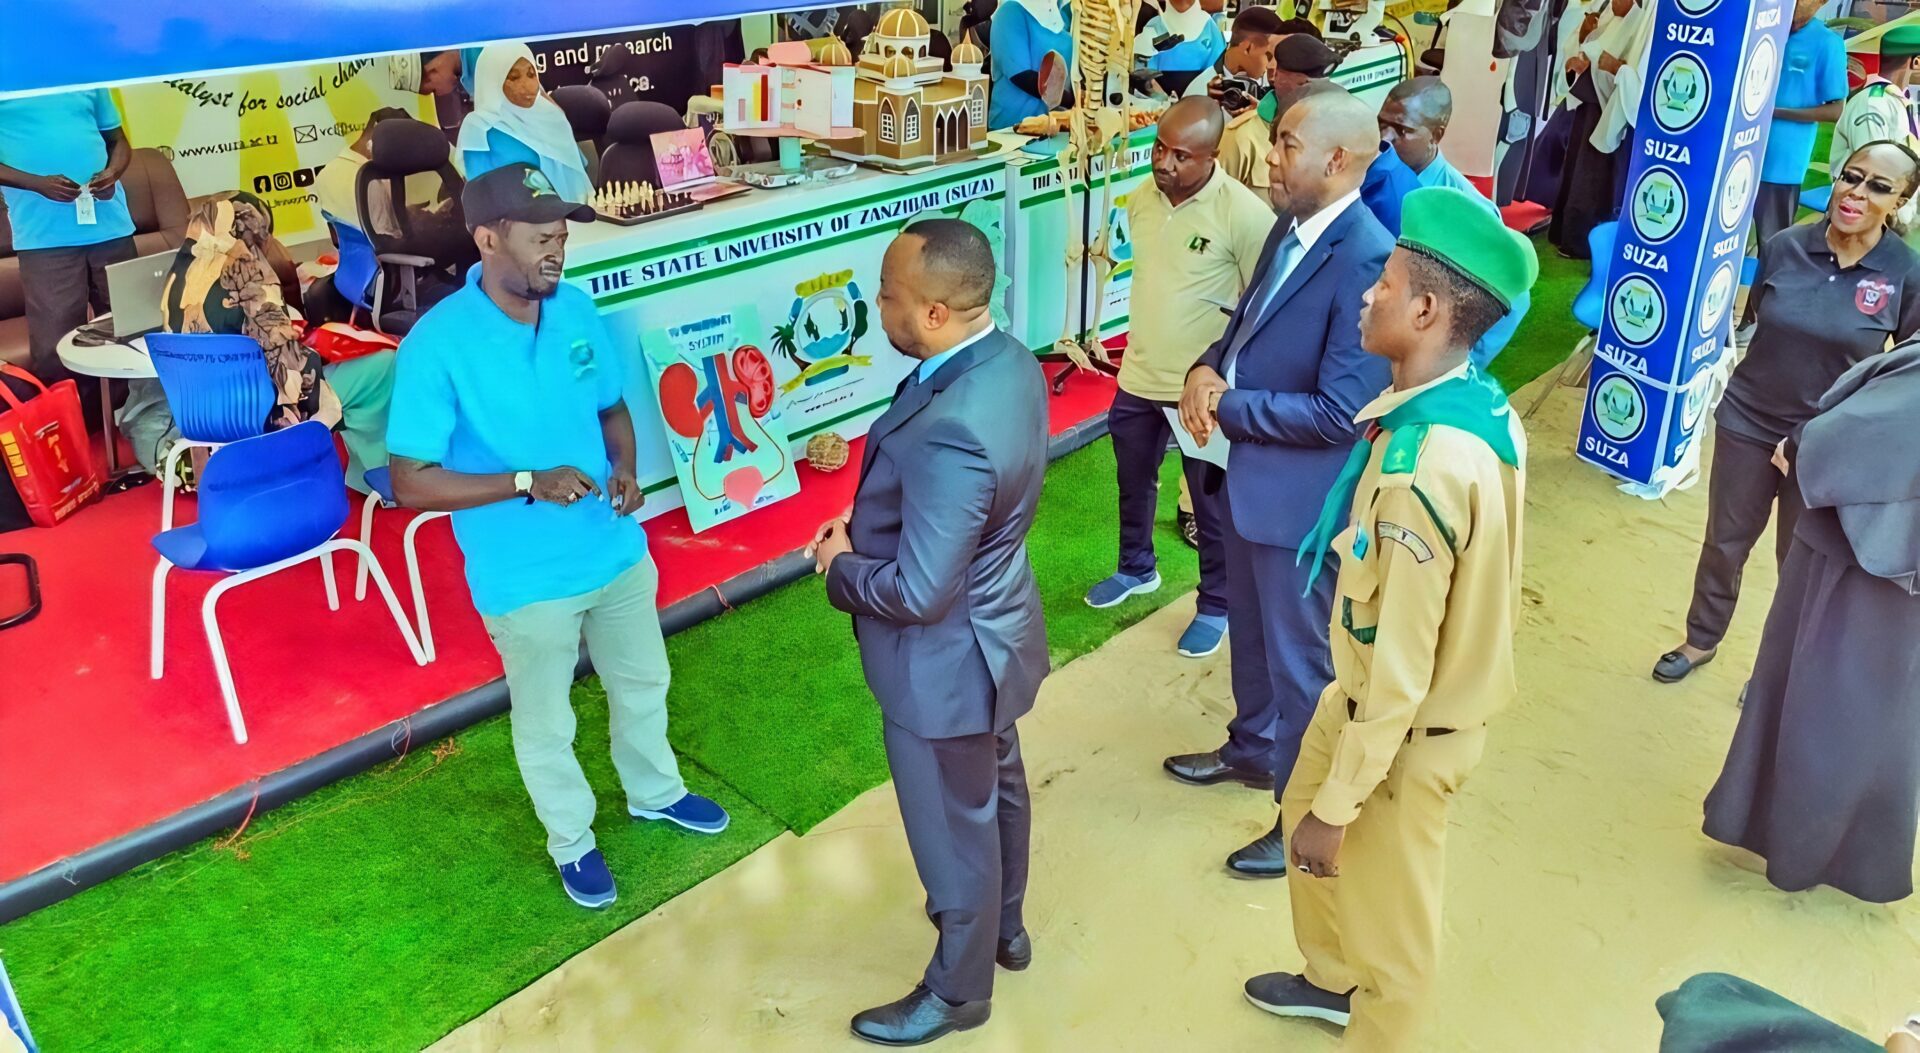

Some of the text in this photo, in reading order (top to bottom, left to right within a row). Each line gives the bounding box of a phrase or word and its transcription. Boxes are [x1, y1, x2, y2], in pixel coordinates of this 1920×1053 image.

[1666, 23, 1714, 46] SUZA
[554, 42, 589, 66] and
[238, 90, 268, 117] for
[276, 75, 327, 109] social
[1644, 138, 1691, 165] SUZA
[586, 269, 634, 295] THE
[641, 251, 708, 281] STATE
[714, 222, 824, 263] UNIVERSITY
[945, 177, 994, 204] (SUZA)
[1622, 243, 1669, 272] SUZA
[1603, 343, 1648, 376] SUZA
[1585, 436, 1629, 469] SUZA
